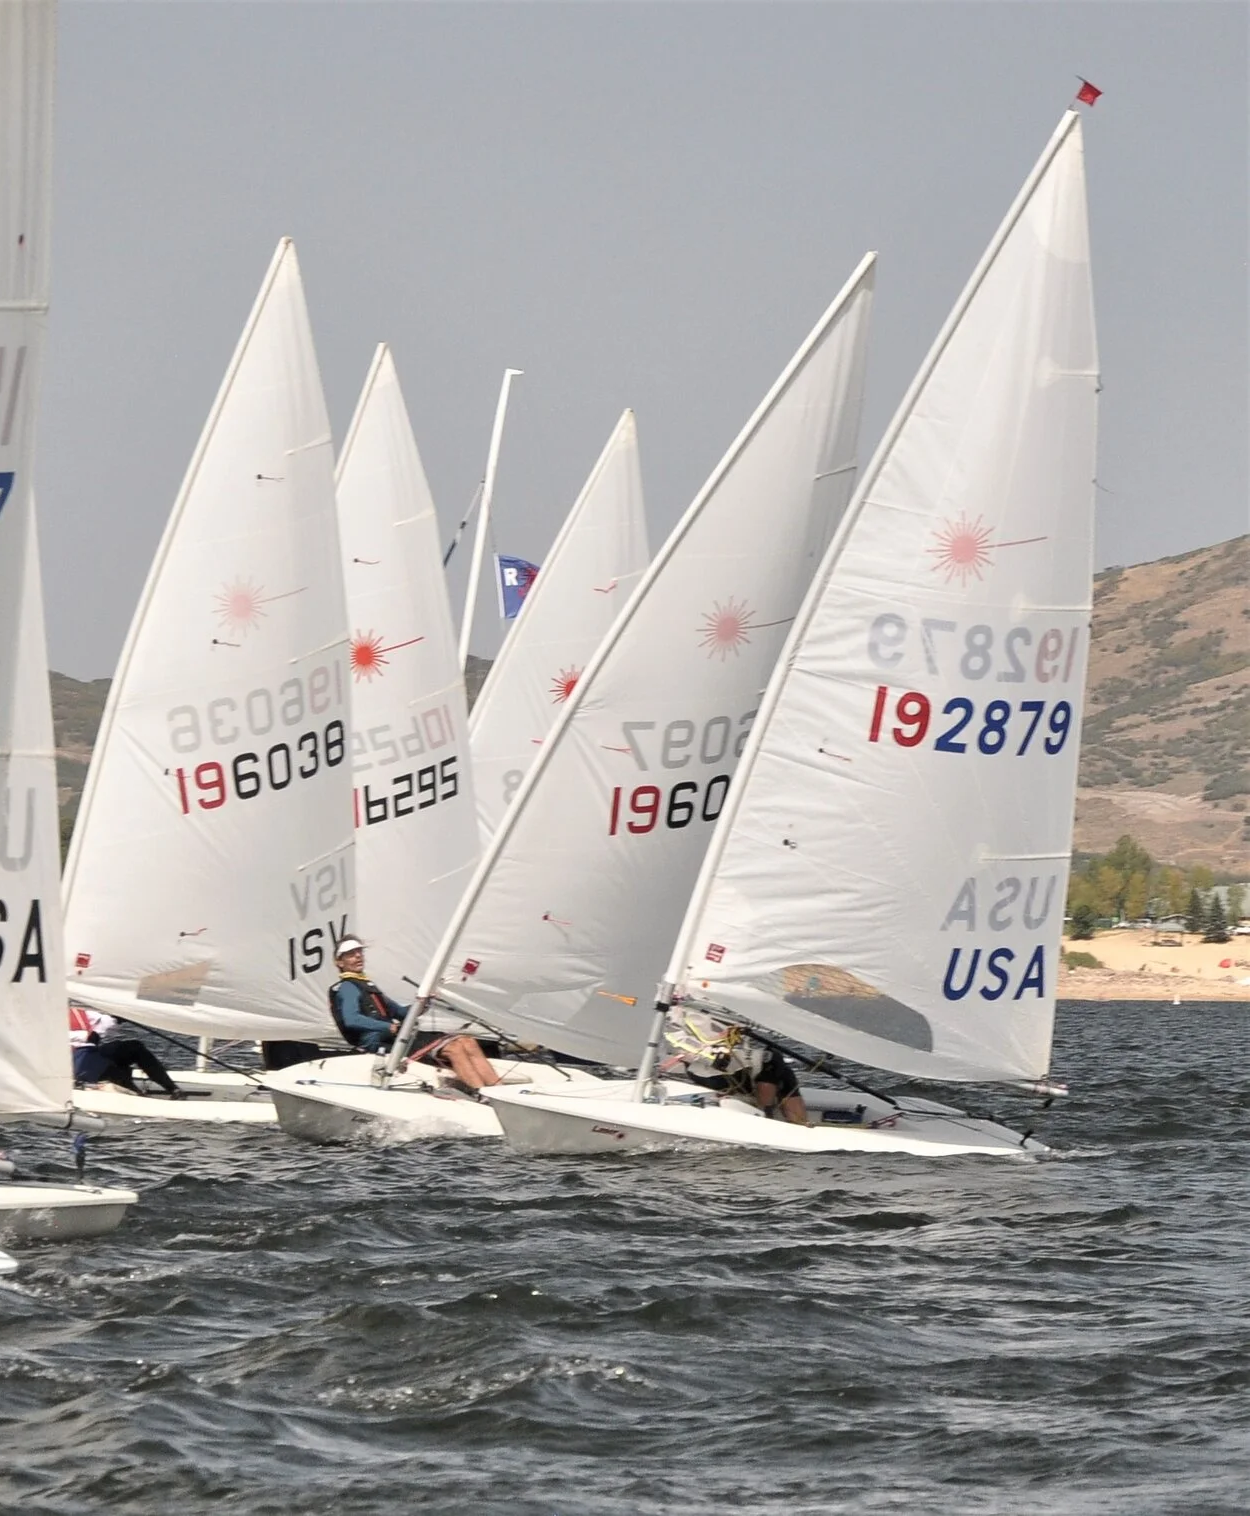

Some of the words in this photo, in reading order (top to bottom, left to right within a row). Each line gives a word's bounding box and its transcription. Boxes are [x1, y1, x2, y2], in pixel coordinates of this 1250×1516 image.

[503, 567, 519, 586] R
[868, 686, 1071, 756] 192879
[177, 719, 345, 814] 196038
[942, 944, 1045, 1001] USA
